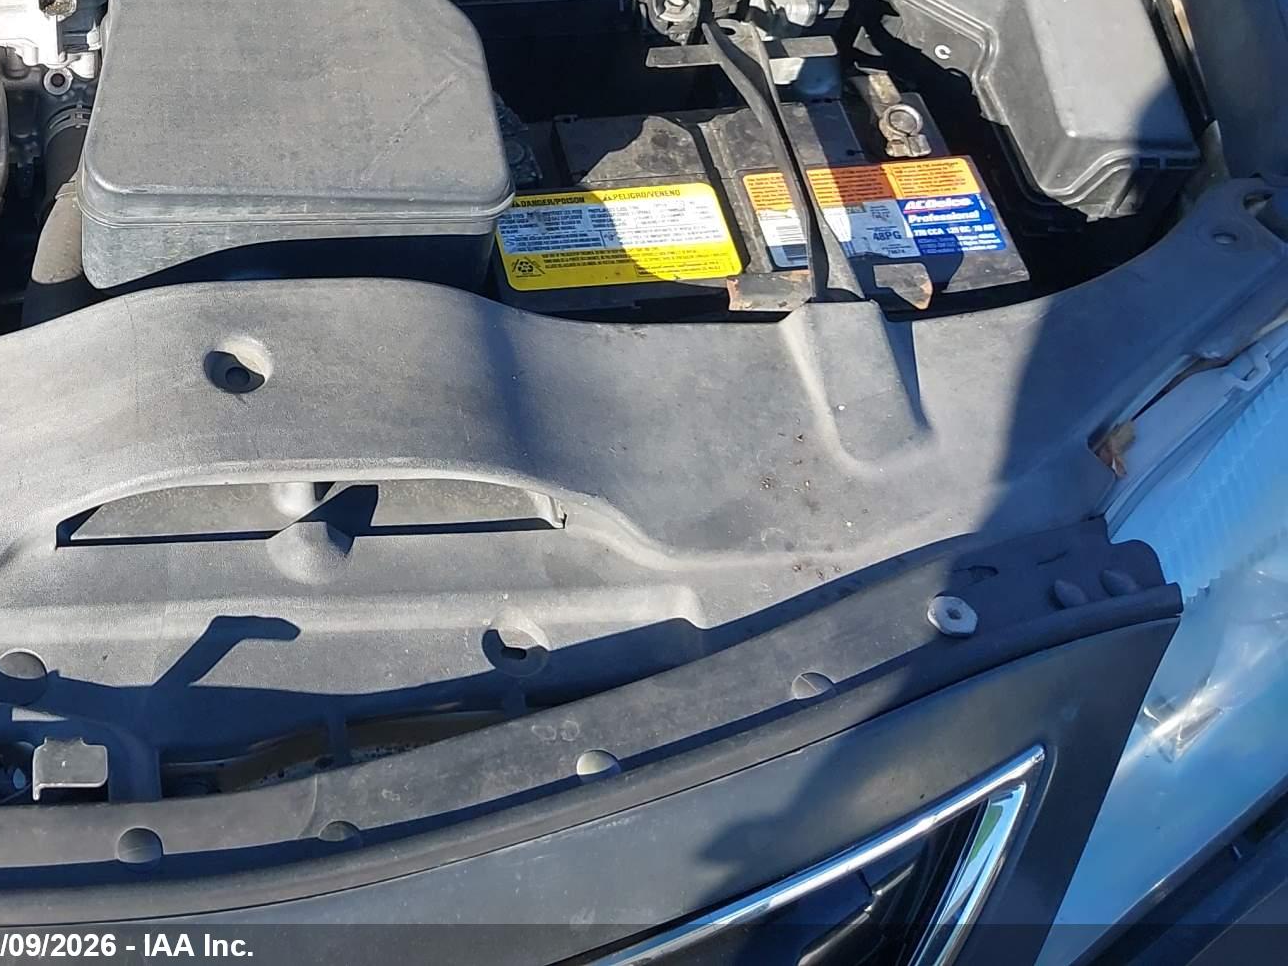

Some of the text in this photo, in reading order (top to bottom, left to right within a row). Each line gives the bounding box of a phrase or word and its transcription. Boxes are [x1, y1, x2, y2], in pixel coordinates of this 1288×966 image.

[520, 196, 585, 207] DANGER/POISON
[904, 198, 972, 211] ACDelco
[908, 210, 980, 223] Professional
[873, 231, 902, 241] 48PG
